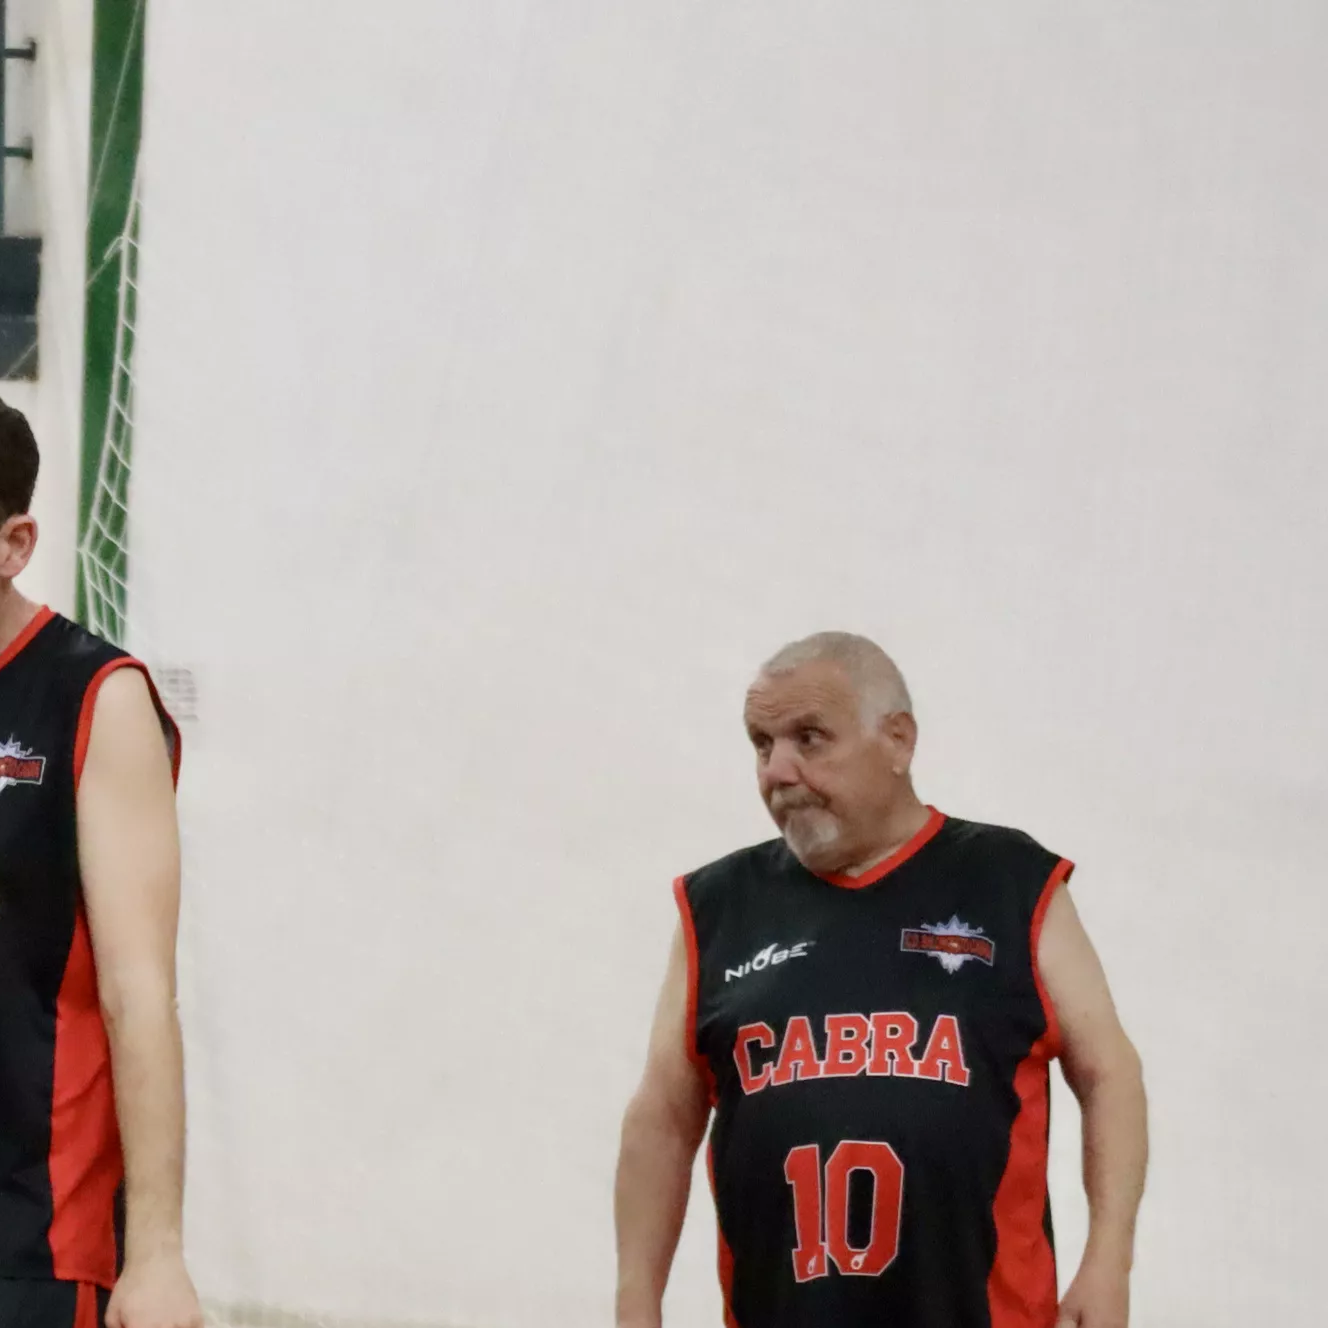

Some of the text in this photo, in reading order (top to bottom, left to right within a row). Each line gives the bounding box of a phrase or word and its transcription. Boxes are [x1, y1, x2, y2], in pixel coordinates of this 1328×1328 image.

[724, 941, 809, 983] NIOBE
[733, 1011, 970, 1097] CABRA
[783, 1139, 905, 1283] 10
